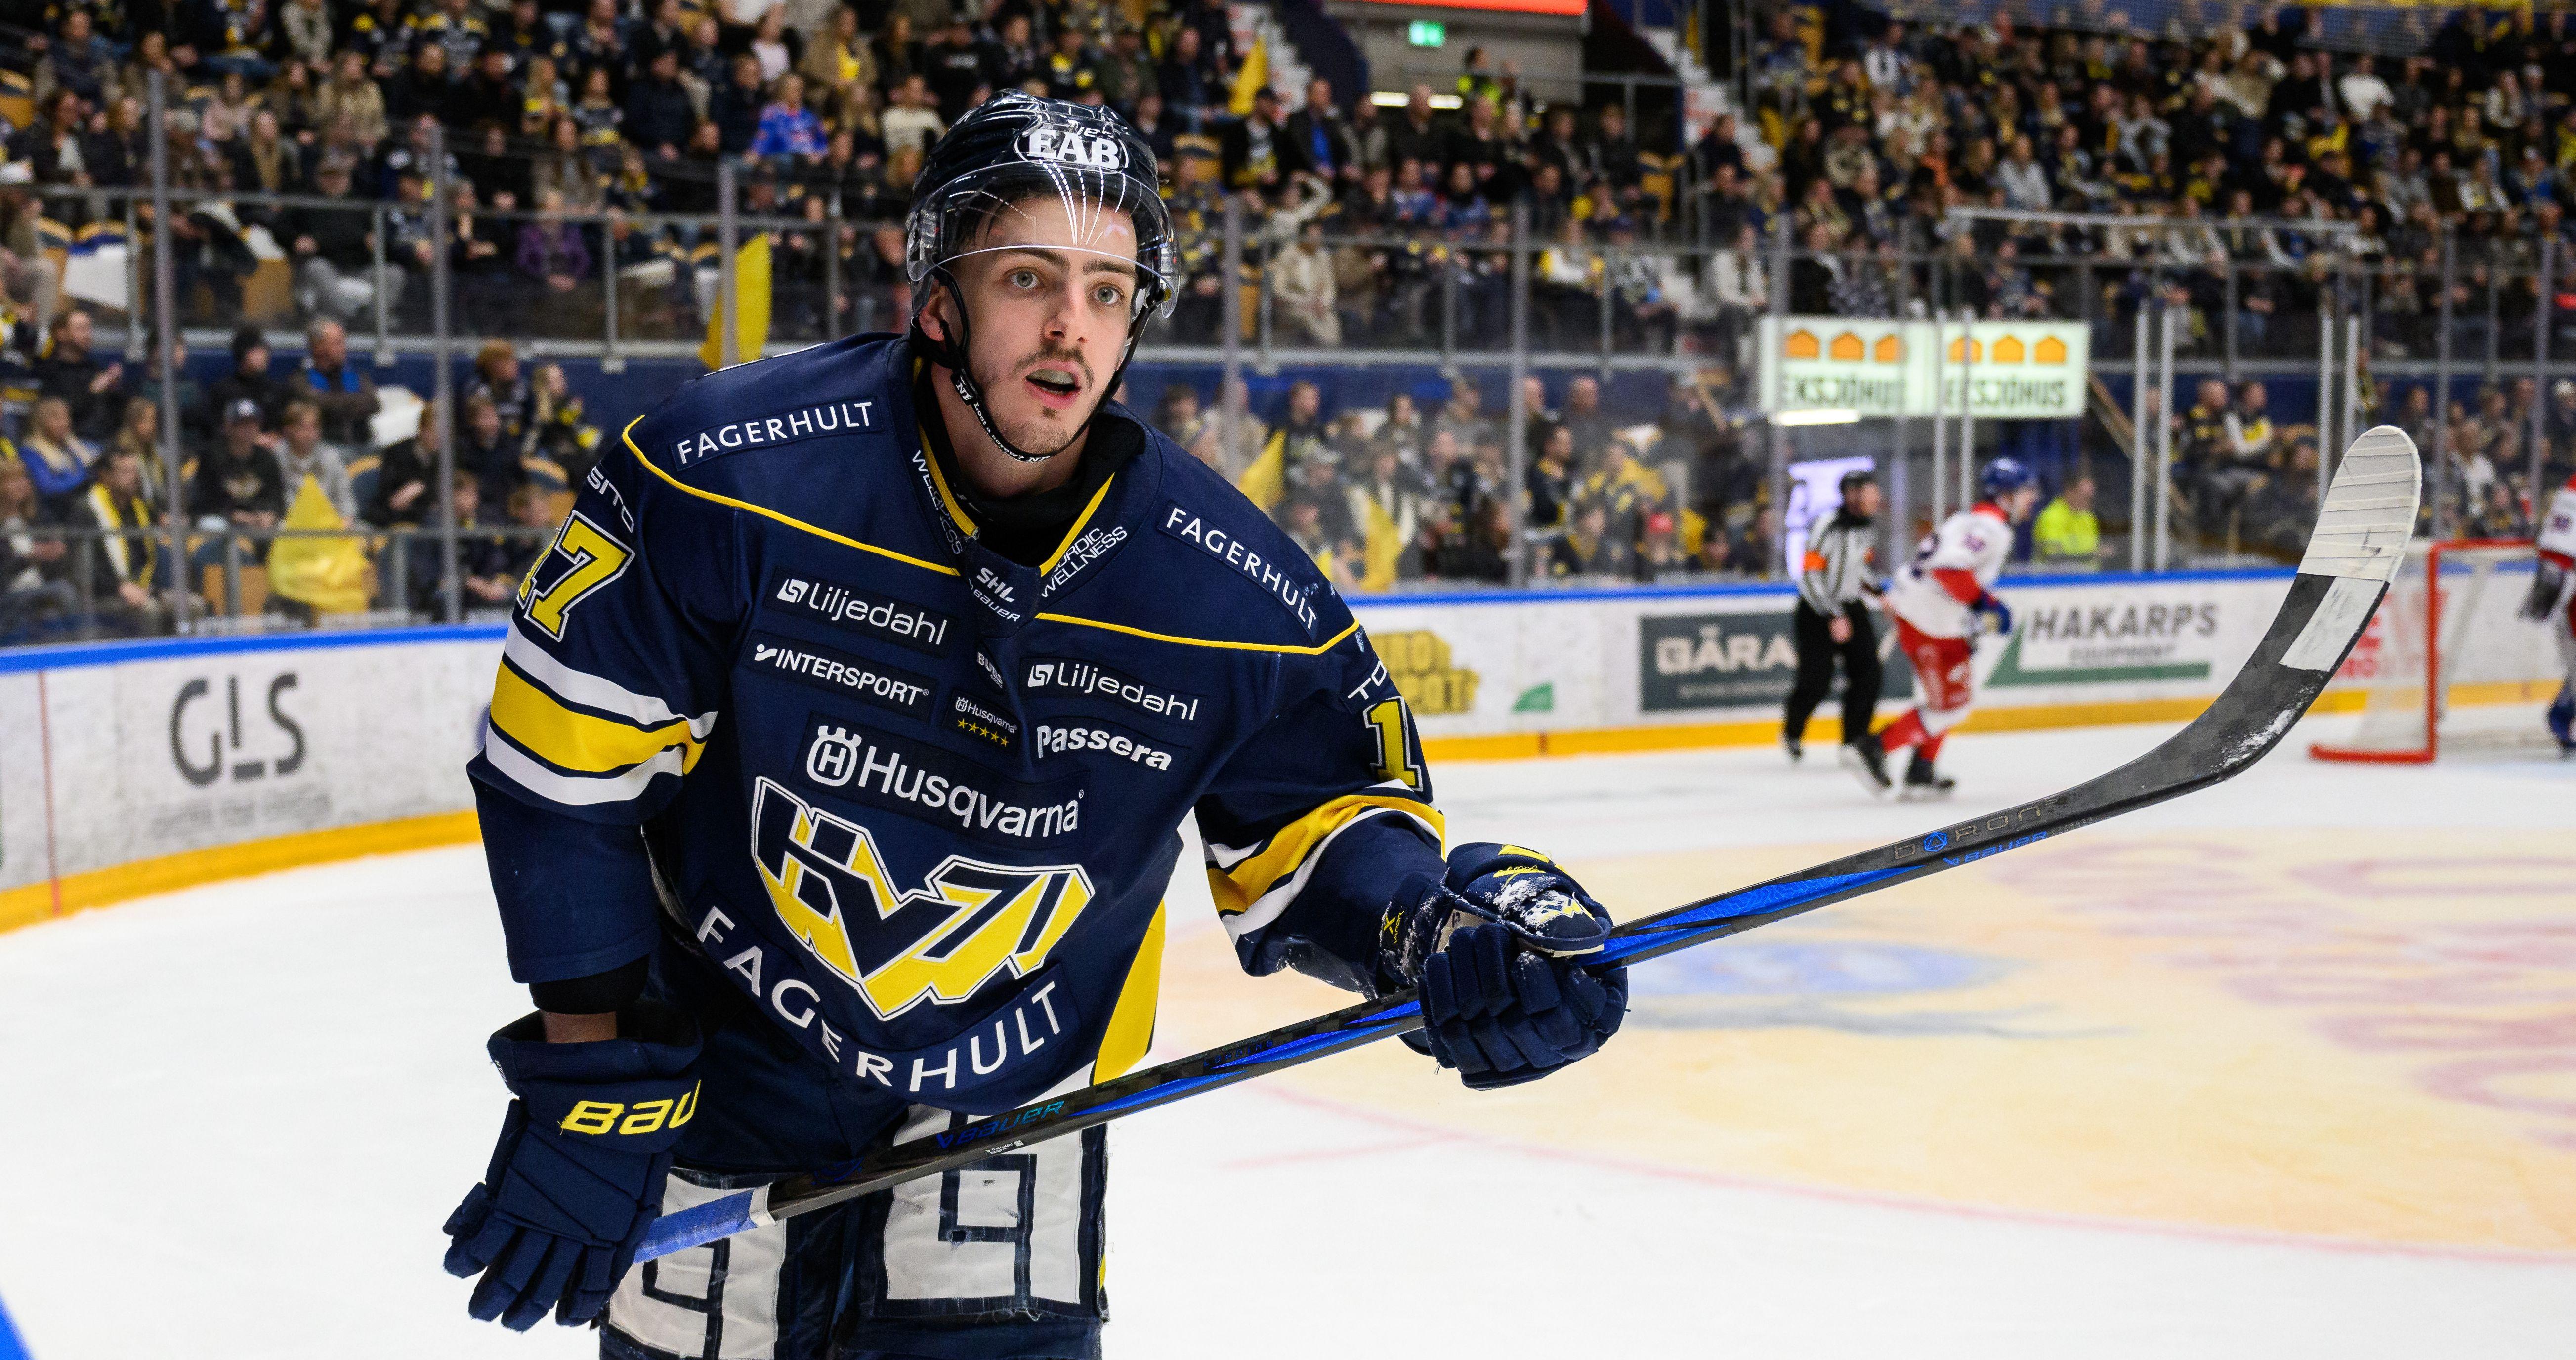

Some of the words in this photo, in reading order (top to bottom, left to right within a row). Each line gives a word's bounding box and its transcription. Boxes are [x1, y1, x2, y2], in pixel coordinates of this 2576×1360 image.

[1027, 129, 1120, 170] EAB
[676, 401, 873, 465] FAGERHULT
[974, 402, 987, 425] Lost
[991, 434, 1025, 460] screw?
[1041, 526, 1128, 598] WELLNESS
[1051, 527, 1104, 574] ORDIC
[1166, 507, 1317, 631] FAGERHULT
[808, 582, 948, 645] Liljedahl
[976, 567, 1015, 603] SHL
[2030, 602, 2220, 641] HAKARPS
[775, 648, 923, 706] INTERSPORT
[1057, 662, 1198, 721] Liljedahl
[169, 671, 306, 788] GLS
[967, 702, 1014, 734] Husqvarna
[1363, 695, 1423, 792] 1
[1037, 725, 1173, 771] Passera
[858, 746, 1079, 838] Husqvarna
[696, 905, 1061, 1092] FAGERHULT
